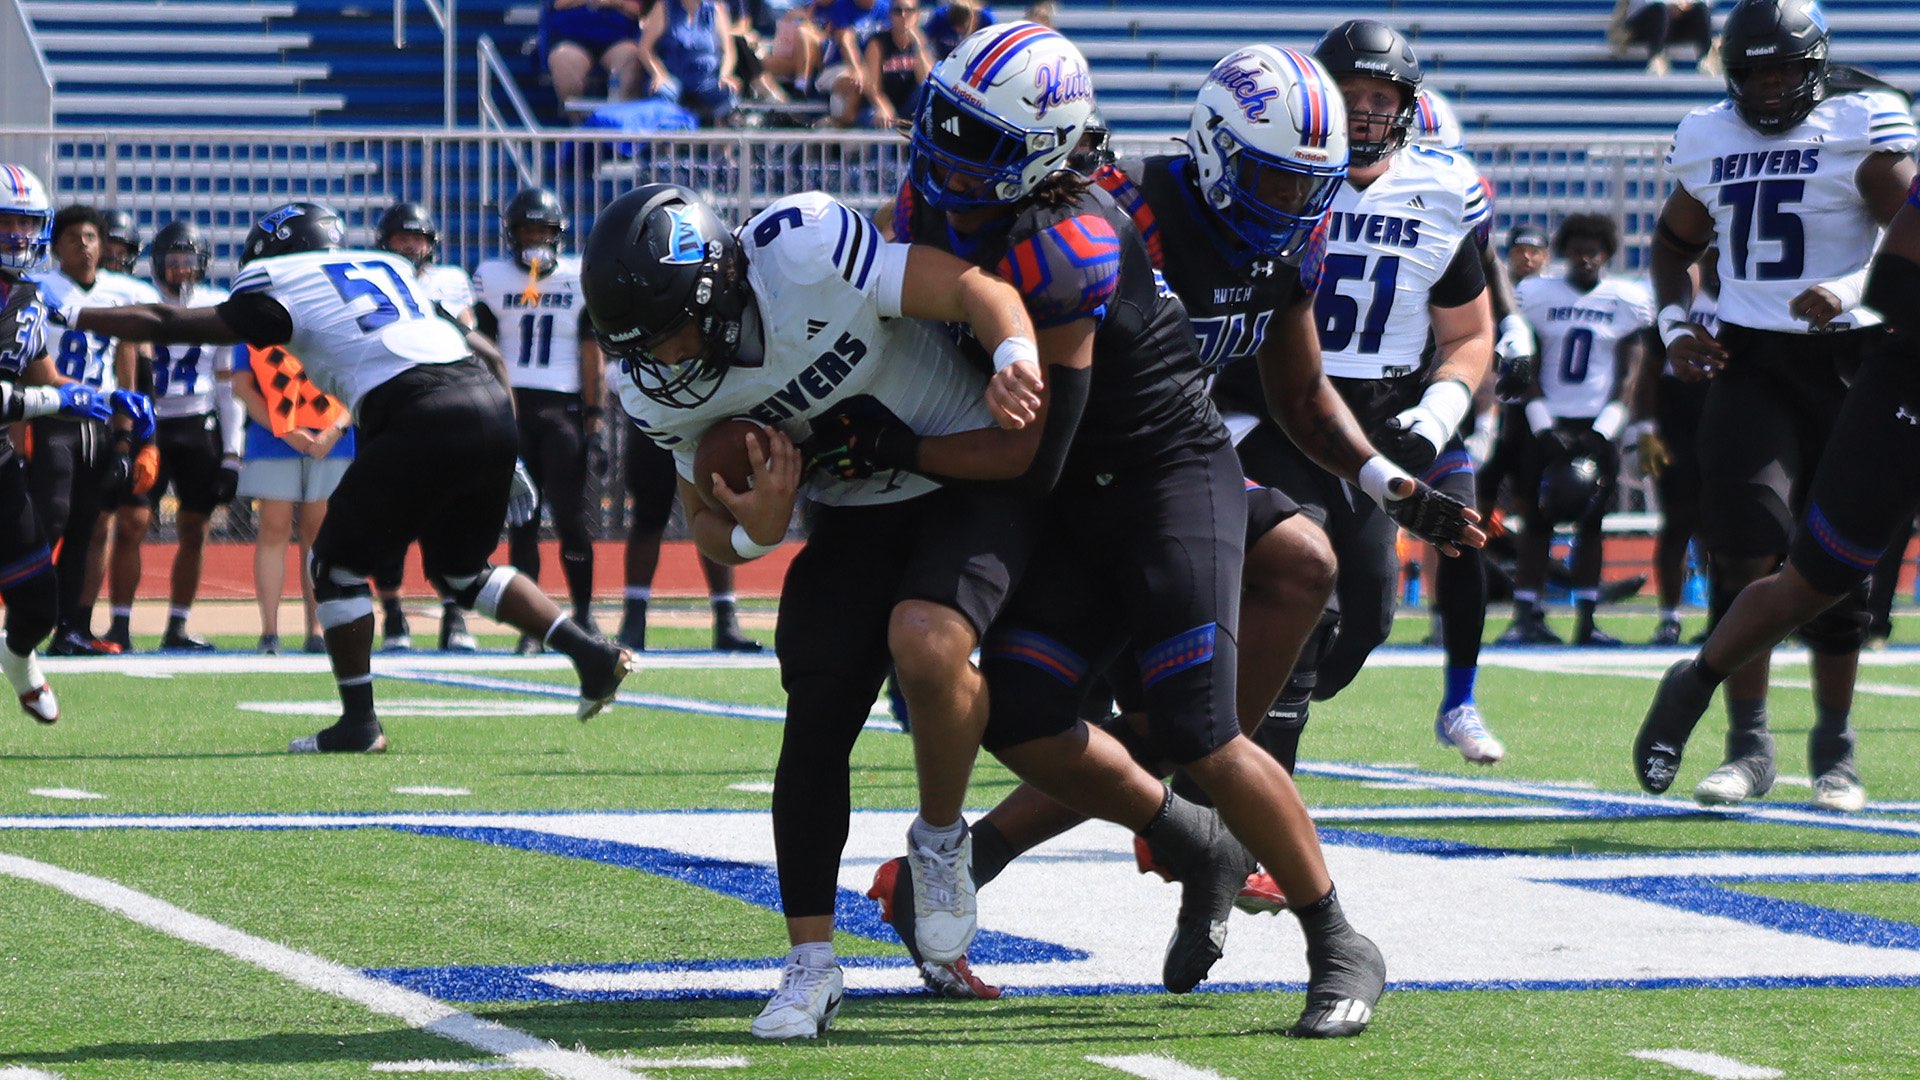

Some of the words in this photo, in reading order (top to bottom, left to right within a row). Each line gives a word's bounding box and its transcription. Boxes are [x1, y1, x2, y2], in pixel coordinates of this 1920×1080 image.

[1354, 61, 1388, 71] Riddell
[1746, 46, 1777, 56] Riddell
[1034, 55, 1093, 121] Hutc
[1294, 150, 1328, 162] Riddell
[1709, 148, 1819, 184] REIVERS
[1328, 211, 1421, 249] IVERS
[1718, 179, 1805, 280] 75
[1213, 287, 1253, 304] HUTCH
[1314, 253, 1400, 354] 61
[1546, 306, 1614, 324] REIVERS
[517, 315, 554, 367] 11
[1558, 326, 1593, 385] 0
[738, 331, 868, 425] EIVERS
